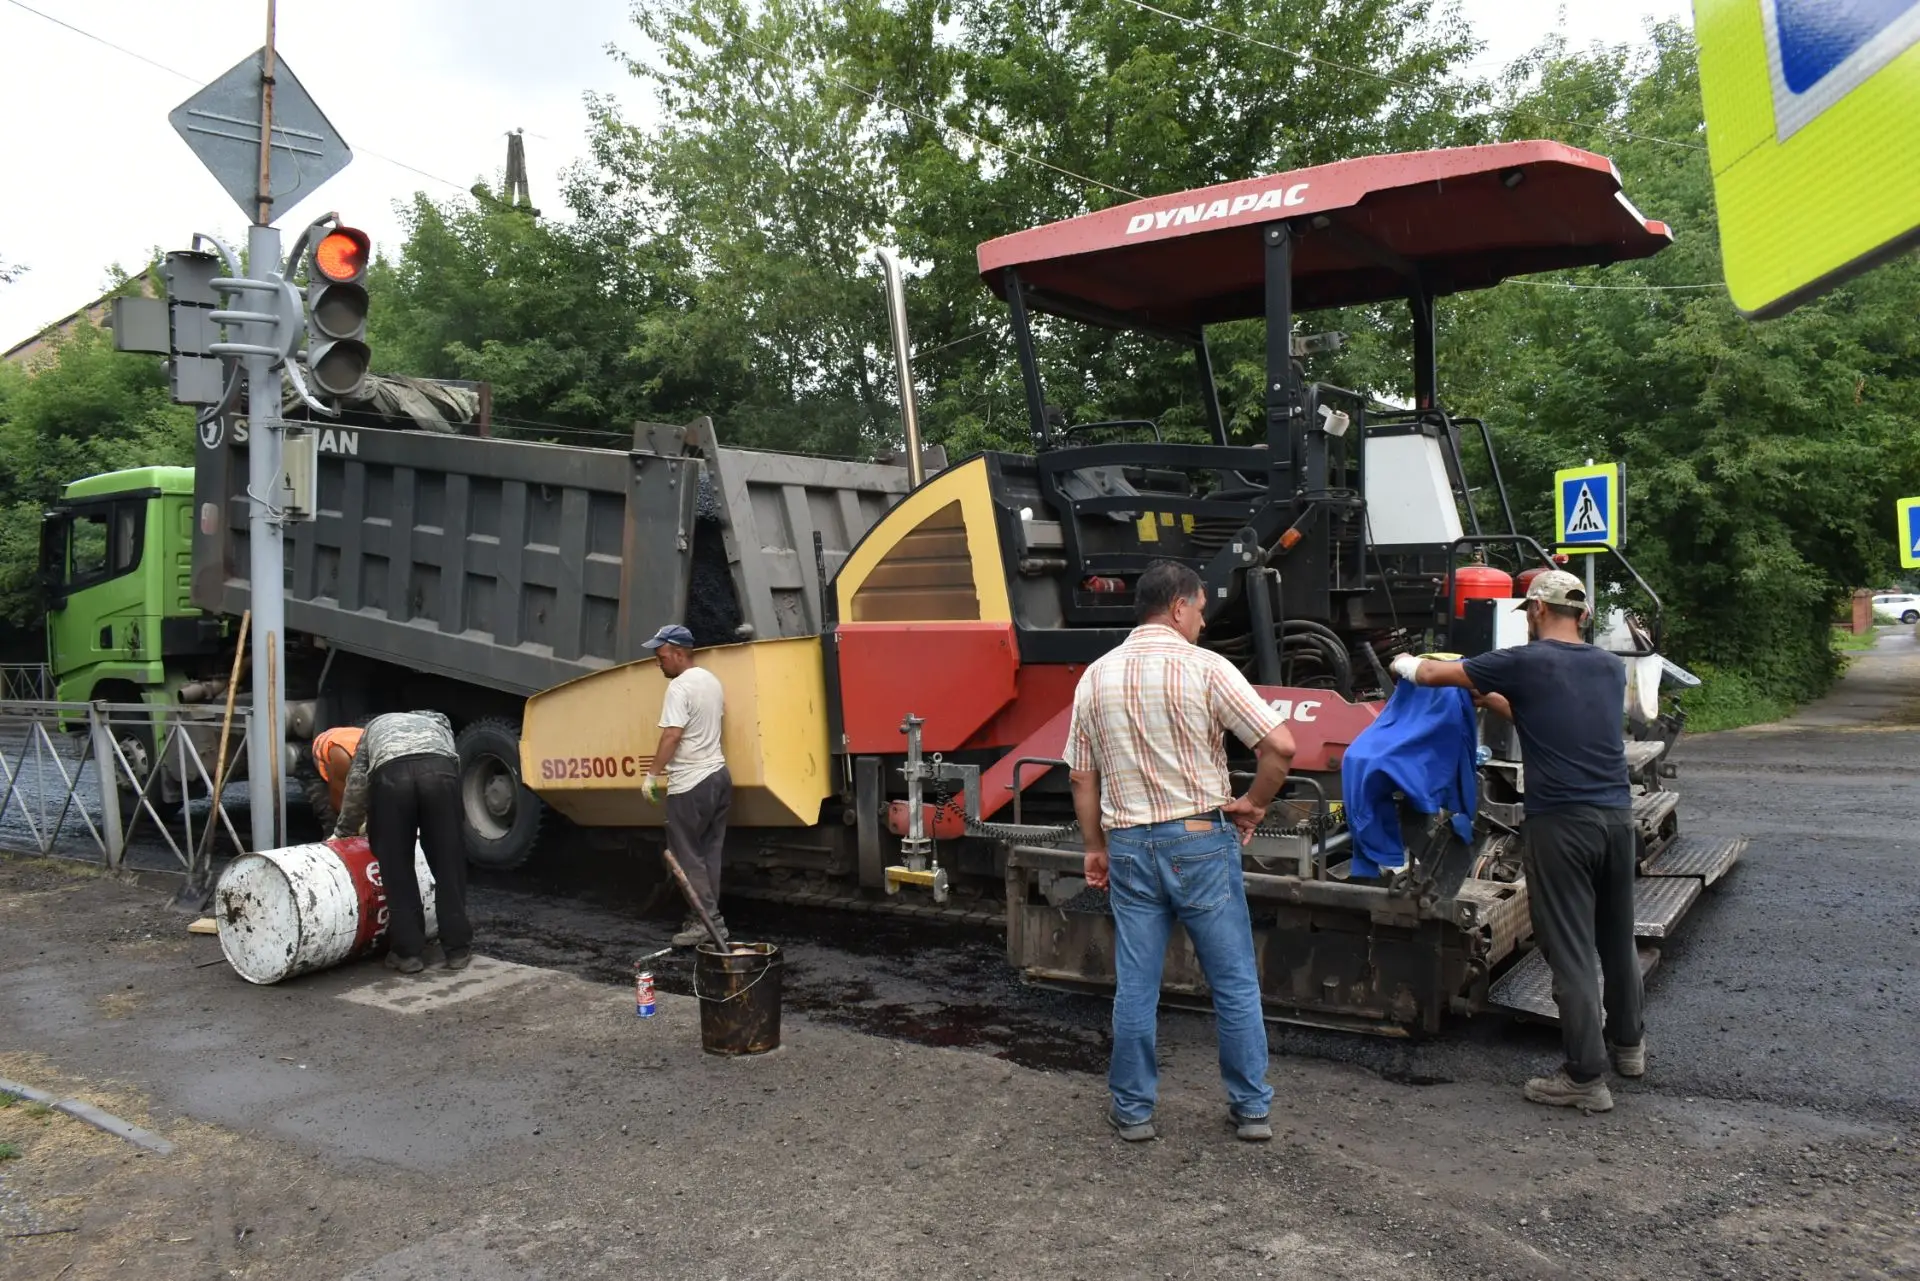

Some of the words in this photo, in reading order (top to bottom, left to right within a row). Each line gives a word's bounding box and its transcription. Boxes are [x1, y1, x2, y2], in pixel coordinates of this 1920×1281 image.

[1125, 183, 1310, 235] DYNAPAC
[541, 756, 618, 780] SD2500
[621, 755, 637, 778] C
